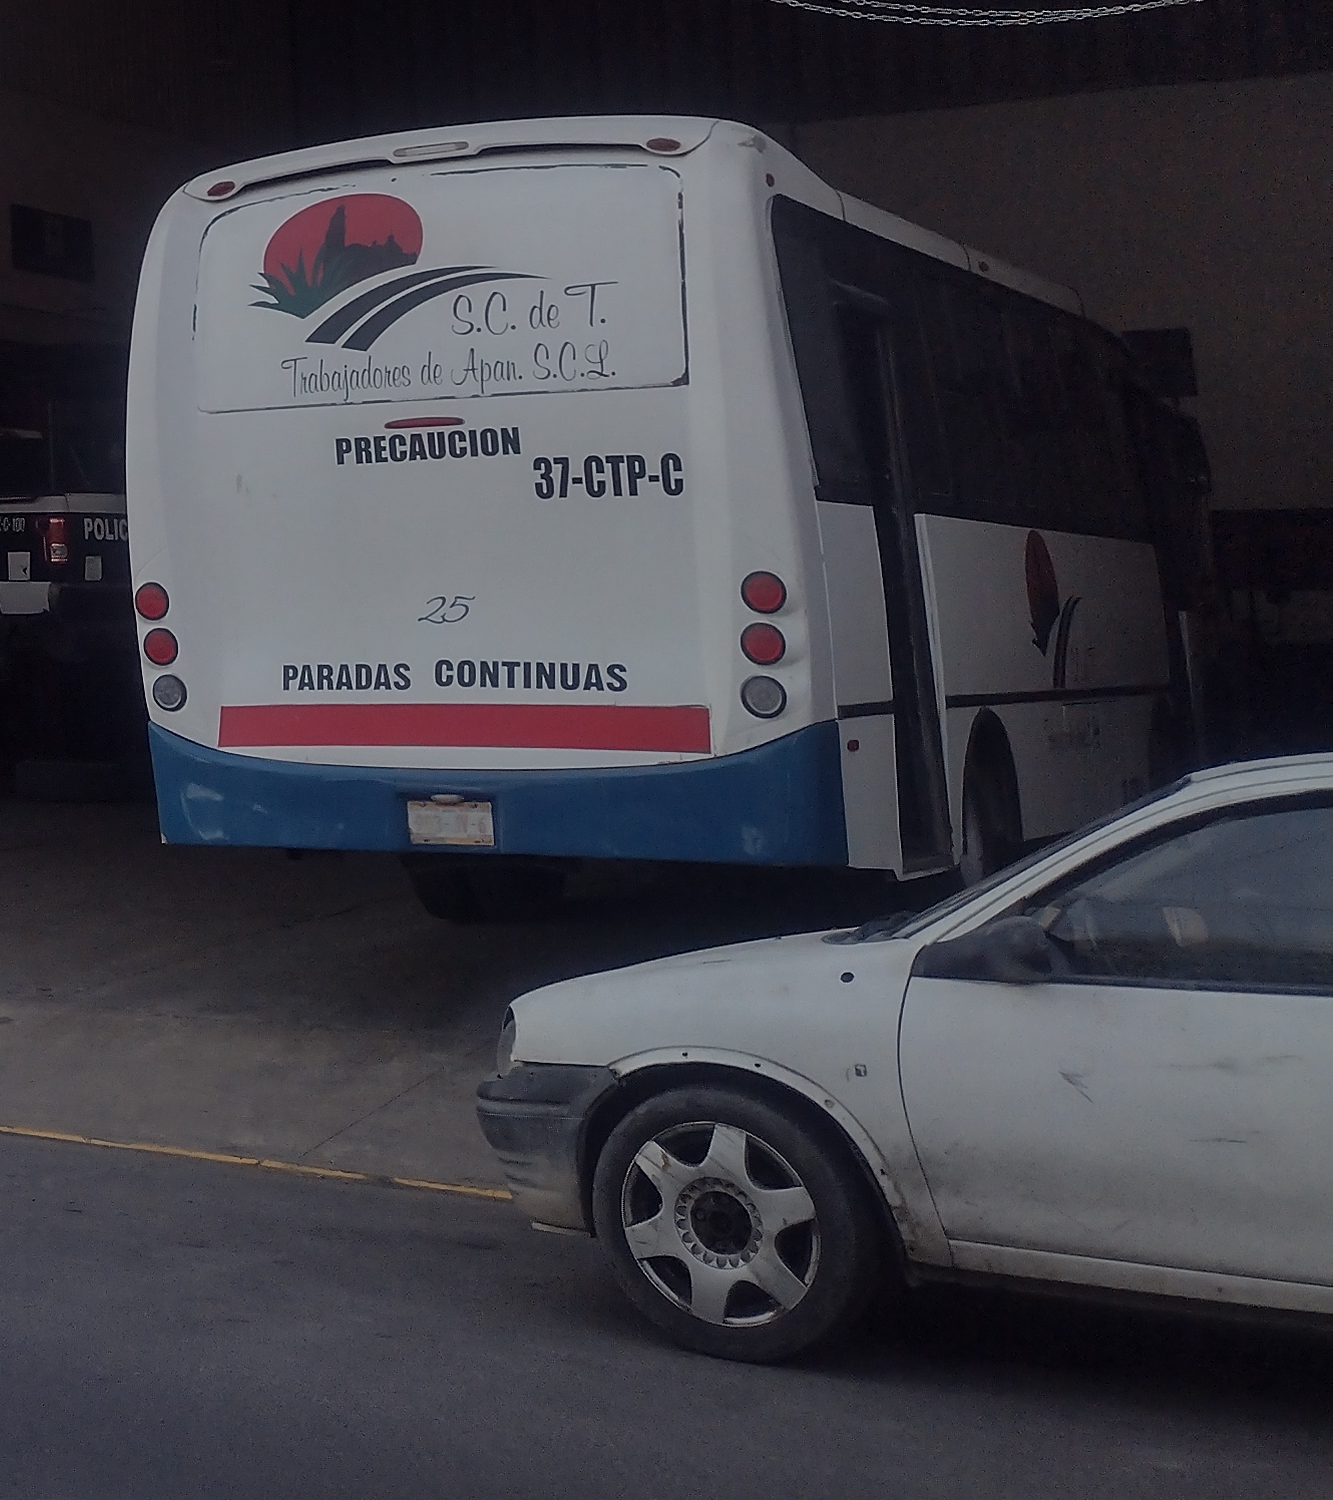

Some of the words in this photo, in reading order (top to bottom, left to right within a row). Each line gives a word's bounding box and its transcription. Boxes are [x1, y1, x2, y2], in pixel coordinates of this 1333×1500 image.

[529, 294, 560, 329] de
[564, 281, 619, 328] T.
[281, 356, 411, 402] Trabajadores
[420, 352, 443, 388] de
[335, 426, 522, 465] PRECAUCION
[533, 452, 684, 500] 37-CTP-C
[417, 595, 476, 624] 25
[282, 663, 412, 691] PARADAS
[434, 659, 628, 692] CONTINUAS
